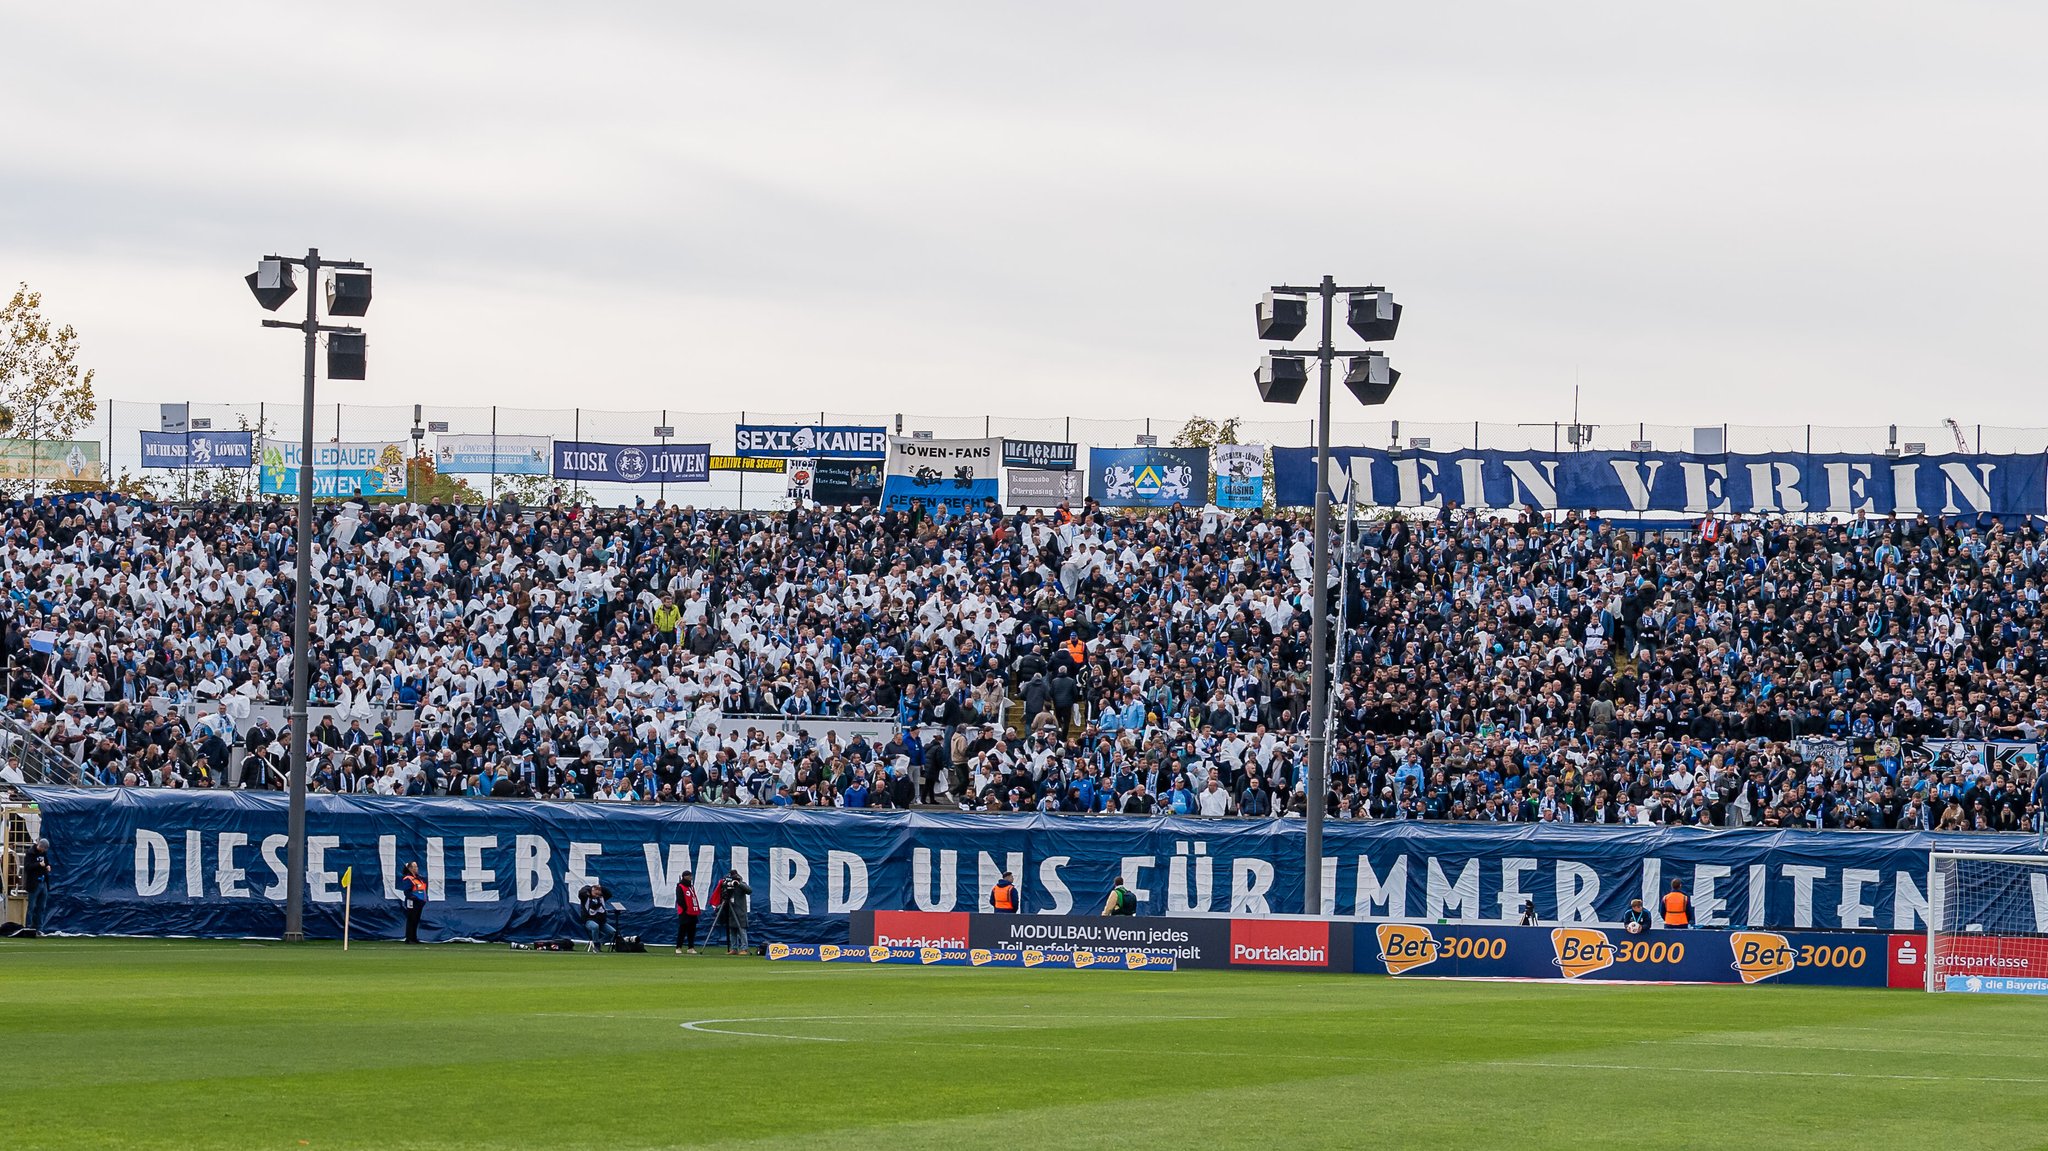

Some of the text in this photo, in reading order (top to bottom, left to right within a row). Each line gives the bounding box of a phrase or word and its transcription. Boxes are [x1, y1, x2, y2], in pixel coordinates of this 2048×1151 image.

[145, 441, 247, 457] MÜHLSEE LÖWEN
[736, 431, 885, 452] SEXI KANER
[284, 444, 376, 465] HOLEDAUER
[1005, 442, 1074, 459] INFLAGRANTI
[563, 451, 706, 473] KIOSK LÖWEN
[709, 456, 784, 469] KREATIVE FÜR SECHZIG
[1311, 455, 1998, 515] MEIN VEREIN
[944, 497, 991, 508] RECHT
[135, 828, 343, 903] DIESE
[379, 834, 603, 904] LIEBE
[643, 843, 869, 915] WIRD
[913, 847, 1075, 915] UNS
[1120, 841, 1275, 914] FÜR
[1321, 854, 1601, 923] IMMER
[1010, 924, 1189, 944] MODULBAU: Wenn jedes
[771, 946, 814, 956] Bet 3000
[822, 948, 865, 957] Bet 3000
[871, 949, 914, 958] Bet 3000
[923, 950, 967, 960] Bet 3000
[1234, 943, 1322, 962] Portakabin
[1386, 934, 1507, 960] Bet 3000
[1561, 937, 1685, 964] Bet 3000
[1740, 941, 1867, 968] Bet 3000
[973, 952, 1017, 961] Bet 3000
[1025, 954, 1069, 962] Bet 3000
[1076, 955, 1093, 963] Bet
[1128, 956, 1173, 965] Bet 3000
[1985, 980, 2048, 991] die Bayeris
